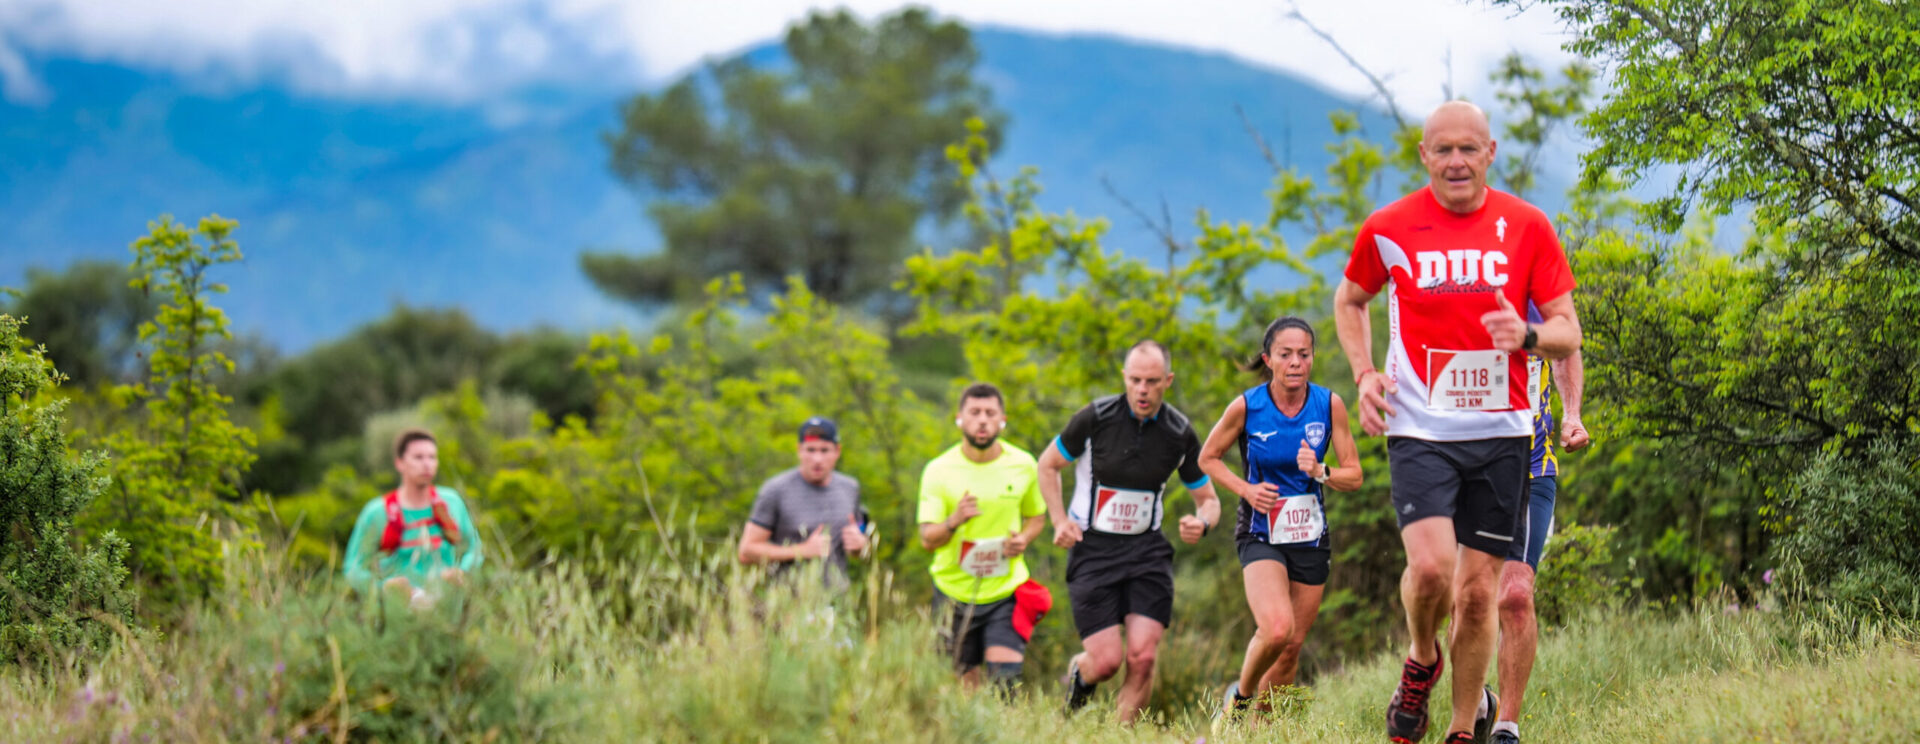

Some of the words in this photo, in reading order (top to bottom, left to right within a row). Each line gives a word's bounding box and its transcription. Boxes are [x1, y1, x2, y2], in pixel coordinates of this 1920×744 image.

[1416, 249, 1508, 287] DUC
[1450, 368, 1488, 387] 1118
[1455, 398, 1466, 407] 13
[1468, 398, 1482, 407] KM
[1112, 503, 1138, 517] 1107
[1285, 508, 1310, 524] 1073
